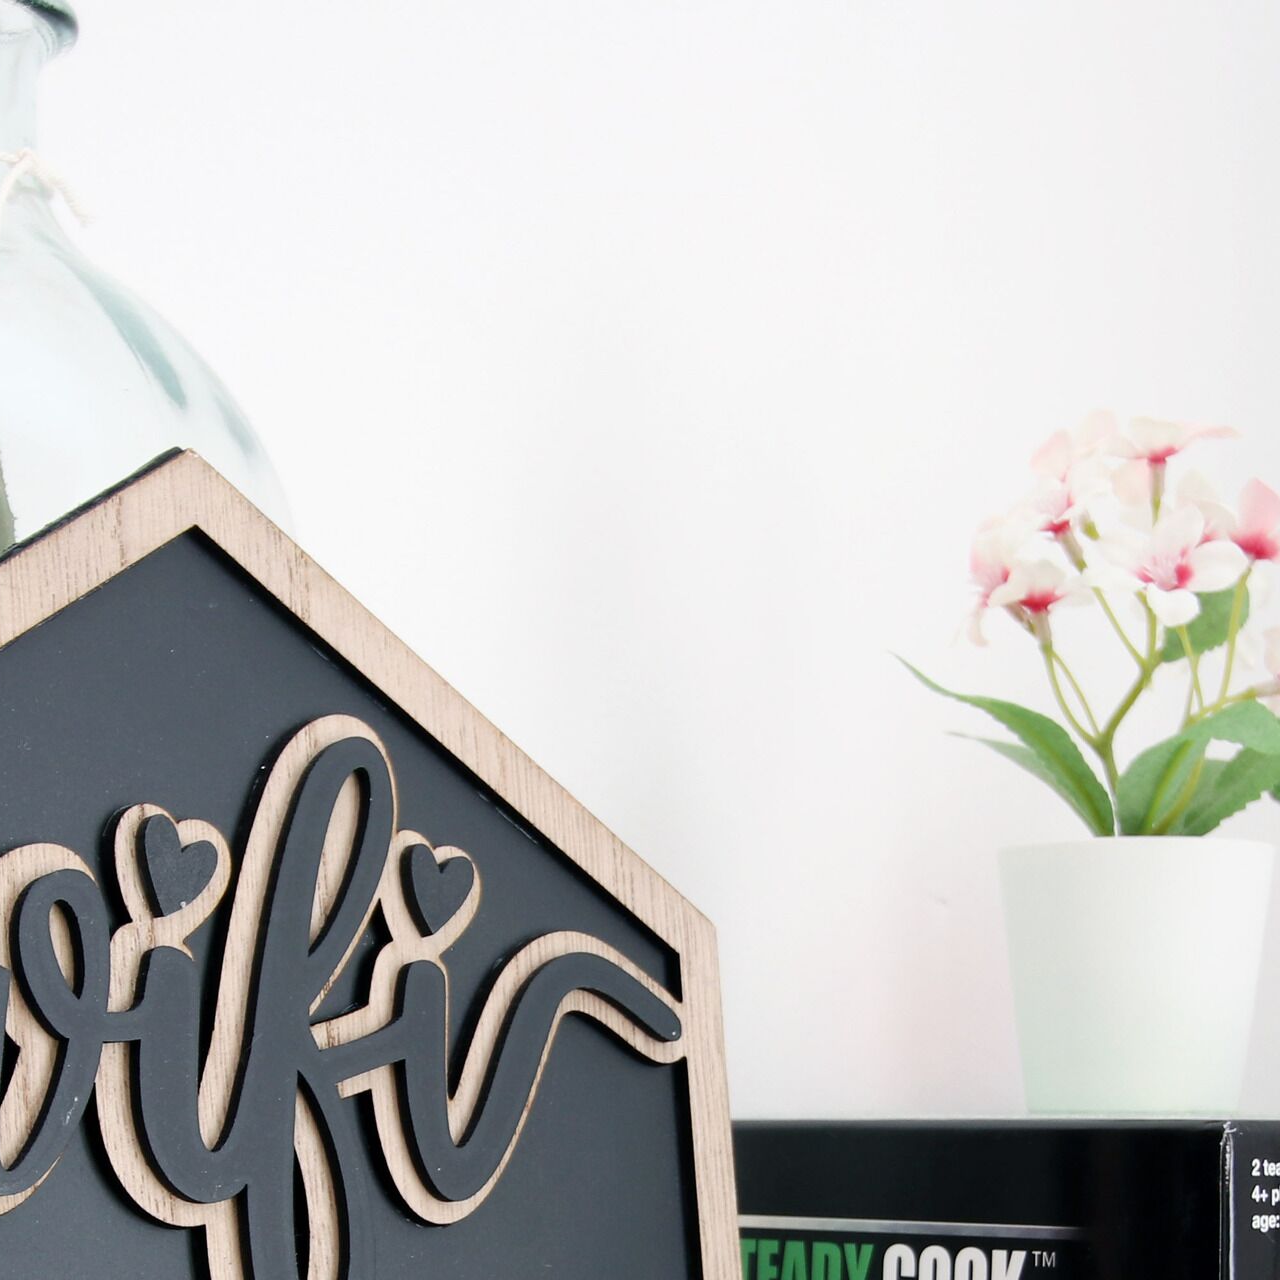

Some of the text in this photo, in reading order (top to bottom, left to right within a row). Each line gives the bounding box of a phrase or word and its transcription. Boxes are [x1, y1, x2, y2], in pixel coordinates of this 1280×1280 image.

[1251, 1158, 1261, 1176] 2
[1251, 1185, 1268, 1202] 4+
[1252, 1214, 1280, 1232] age:
